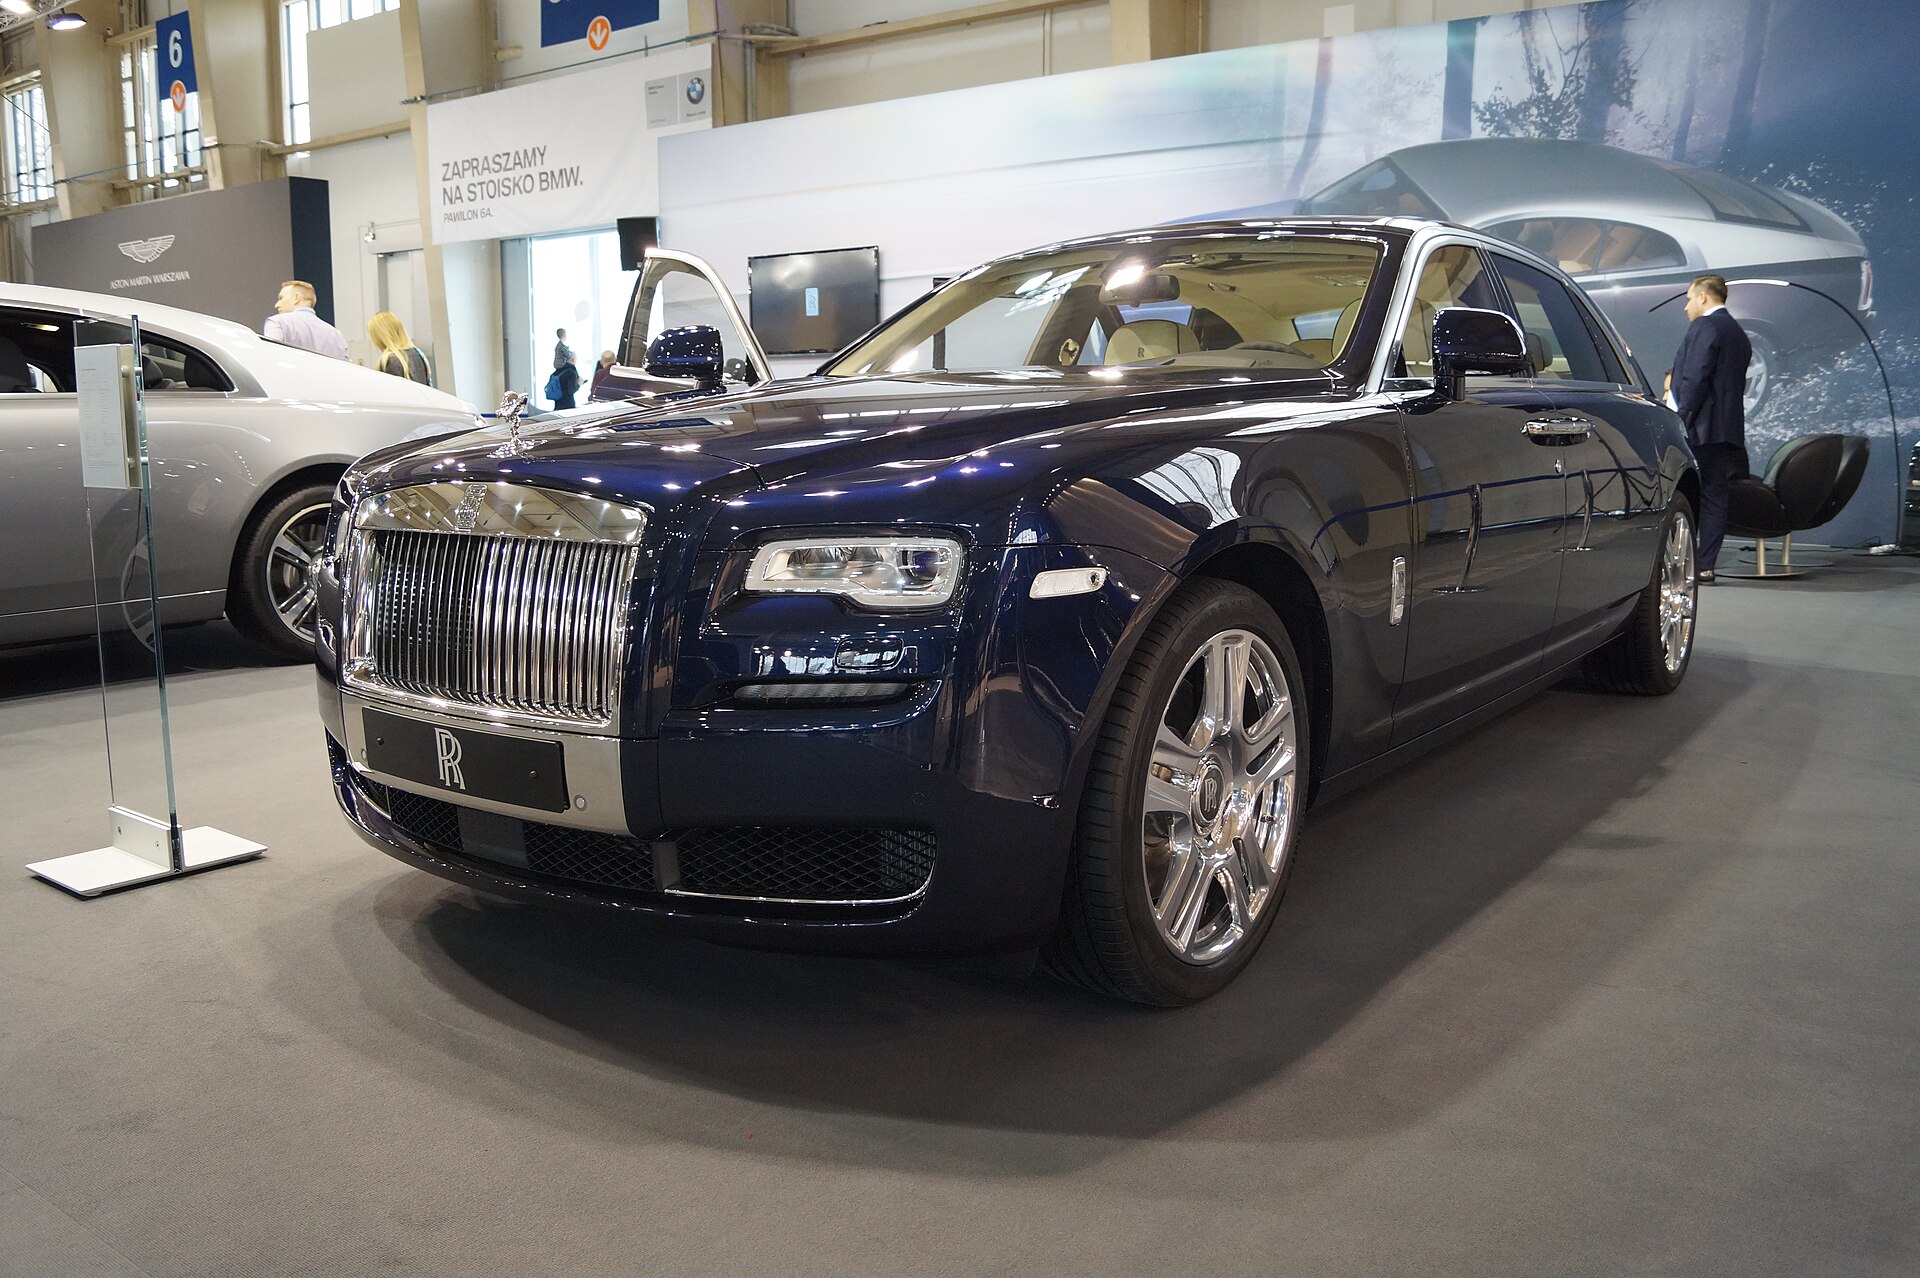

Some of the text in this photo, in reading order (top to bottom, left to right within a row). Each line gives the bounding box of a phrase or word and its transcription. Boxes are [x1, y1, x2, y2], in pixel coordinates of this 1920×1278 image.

[169, 30, 182, 68] 6
[442, 145, 547, 182] ZAPRASZAMY
[443, 166, 583, 206] NA STOISKO BMW.
[444, 207, 494, 223] PAWILON 6A.
[110, 270, 190, 290] ASTON MARTIN WARSZAWA
